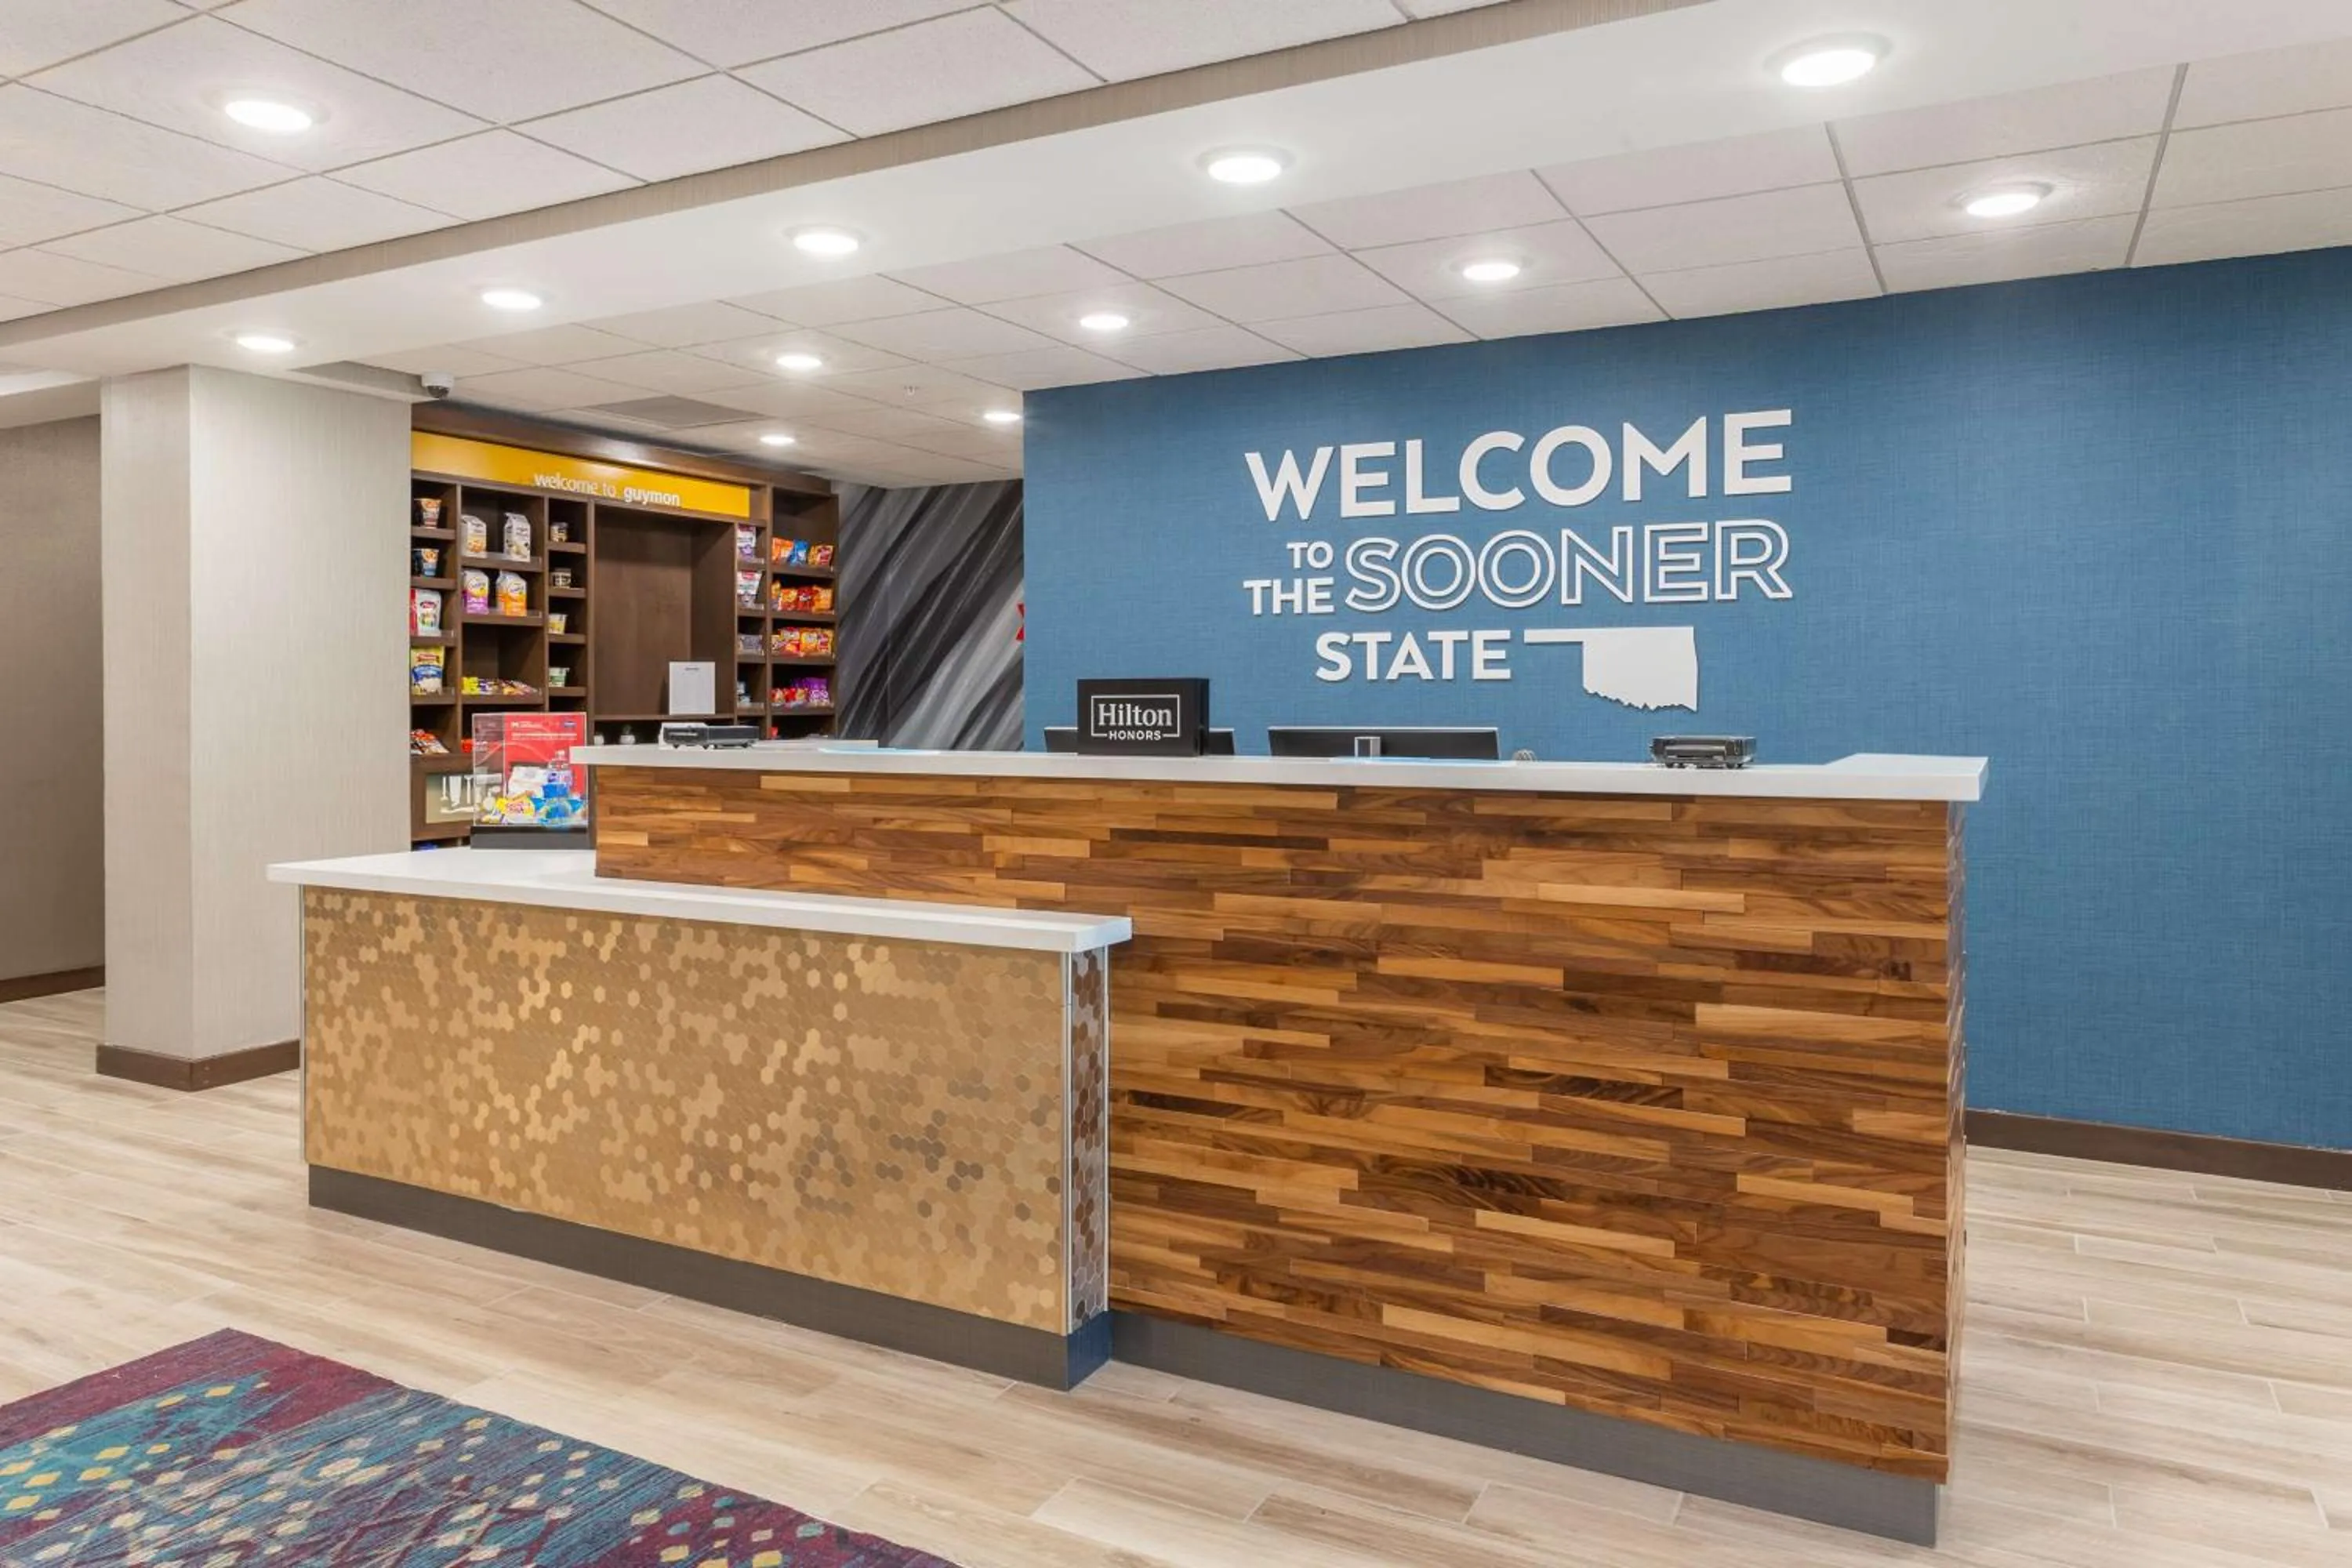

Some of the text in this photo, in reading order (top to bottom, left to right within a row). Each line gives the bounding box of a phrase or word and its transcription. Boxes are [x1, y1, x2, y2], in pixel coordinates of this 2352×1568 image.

[1244, 409, 1792, 521] WELCOME
[534, 473, 680, 506] welcome to guymon
[1243, 518, 1793, 615] THE SOONER
[1287, 541, 1334, 569] TO
[1315, 630, 1512, 682] STATE
[1098, 703, 1173, 727] Hilton
[1109, 730, 1162, 741] HONORS
